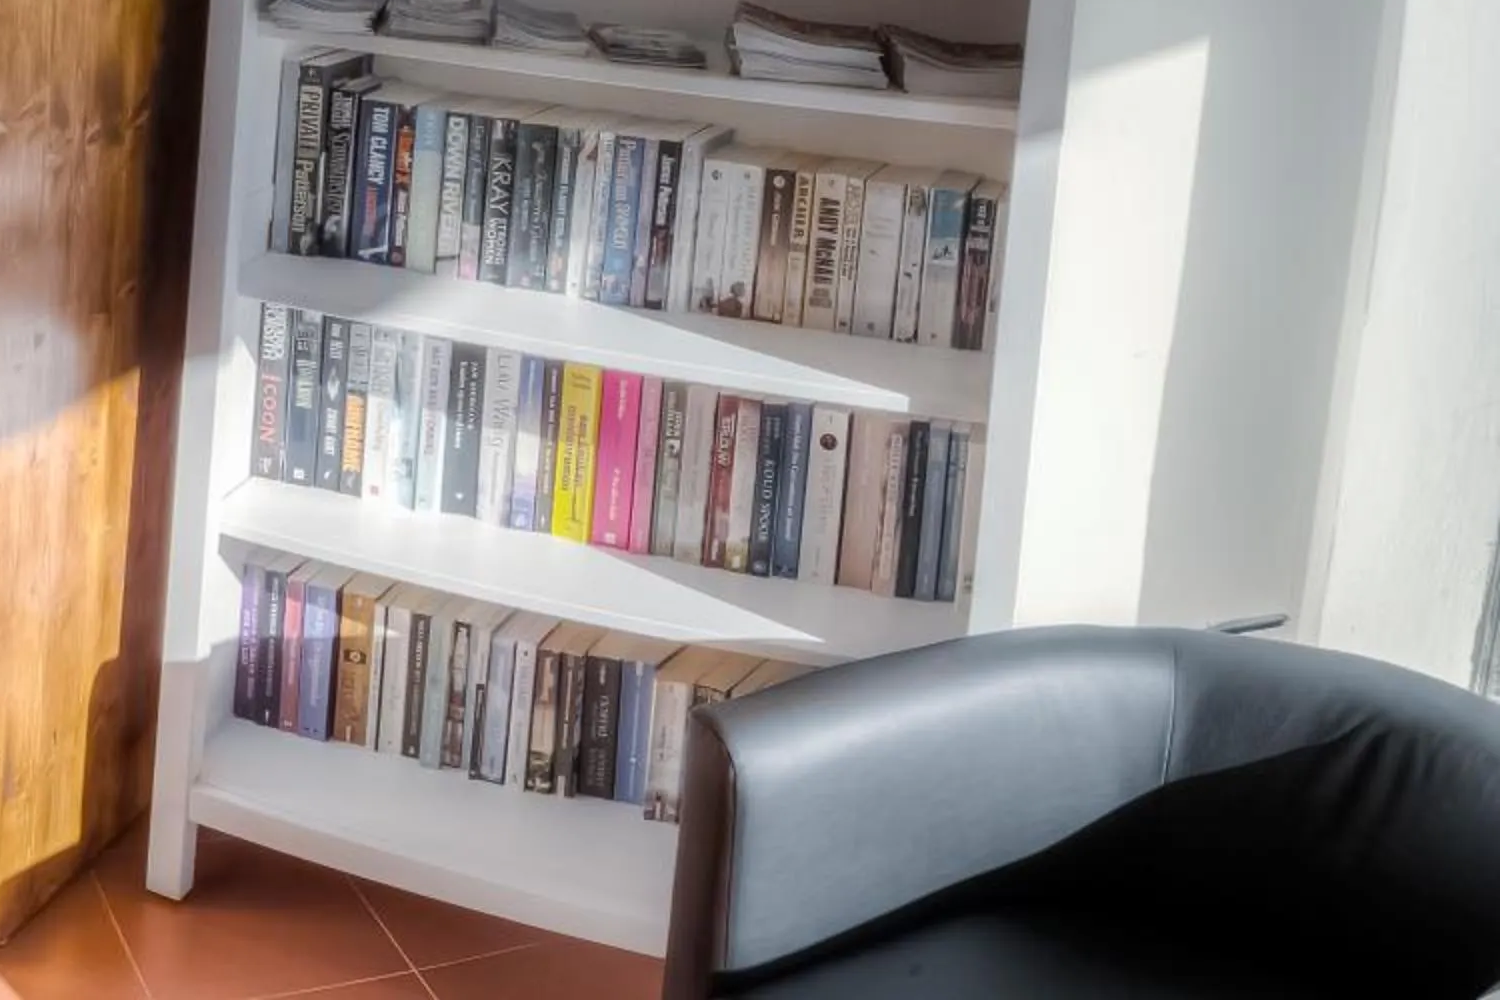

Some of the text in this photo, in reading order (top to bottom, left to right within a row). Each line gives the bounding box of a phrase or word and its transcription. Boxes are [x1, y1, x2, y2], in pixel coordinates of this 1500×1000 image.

[373, 106, 390, 132] TOM
[367, 136, 388, 185] CLANCY
[447, 117, 466, 178] DOWN
[489, 156, 512, 214] KRAY
[817, 197, 841, 234] ANDY
[259, 373, 282, 442] ICOON
